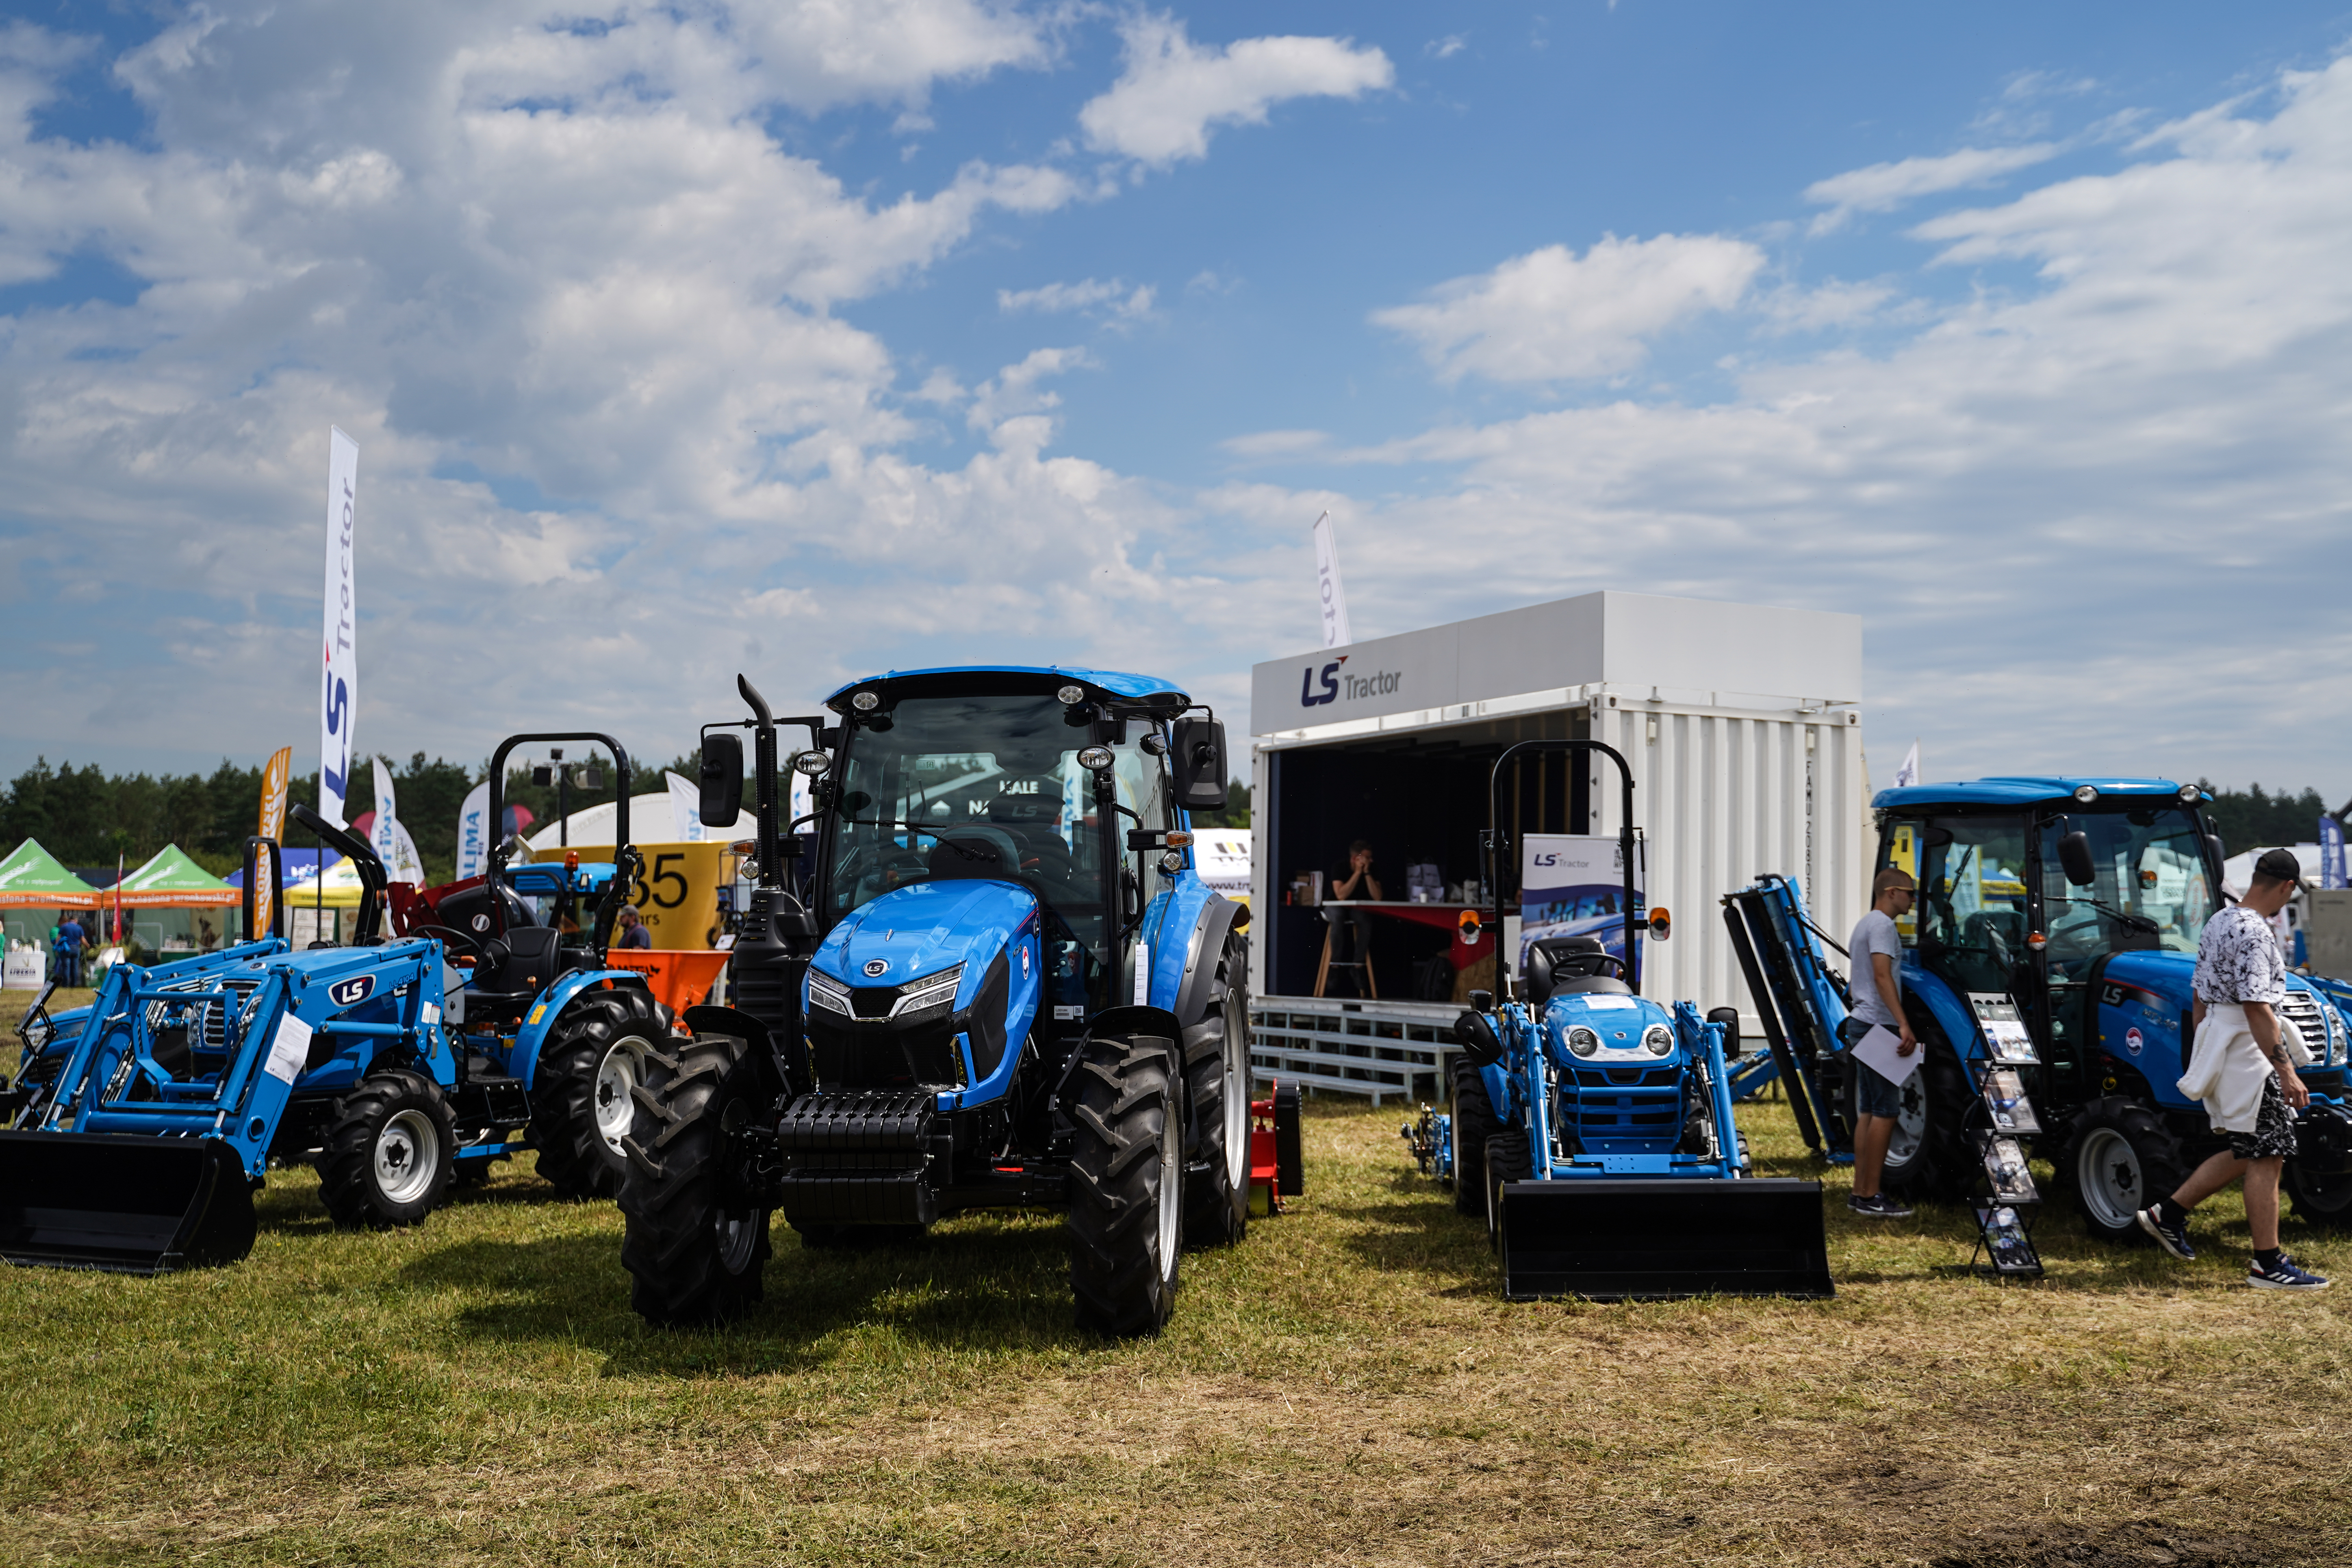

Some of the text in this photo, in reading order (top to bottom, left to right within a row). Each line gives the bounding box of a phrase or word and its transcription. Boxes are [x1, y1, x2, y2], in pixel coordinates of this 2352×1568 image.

[325, 477, 352, 800] LS Tractor
[1302, 662, 1402, 707] LS Tractor
[1011, 806, 1038, 817] LS
[1534, 853, 1589, 868] LS Tractor
[389, 972, 414, 989] LL4104
[342, 981, 363, 1003] LS
[2102, 985, 2122, 1004] LS
